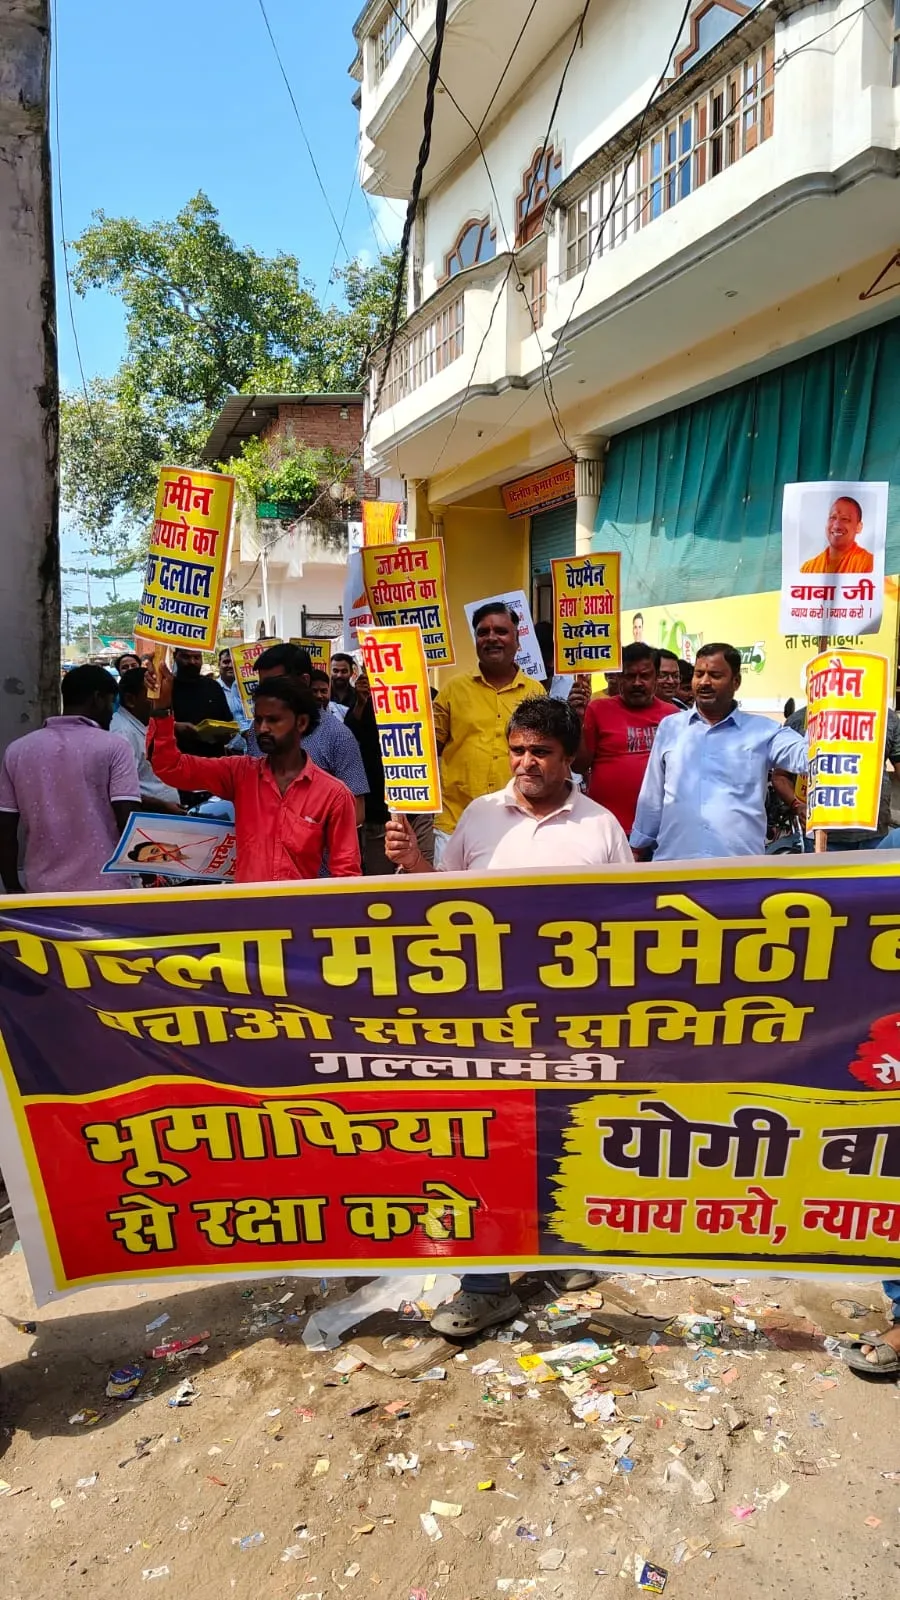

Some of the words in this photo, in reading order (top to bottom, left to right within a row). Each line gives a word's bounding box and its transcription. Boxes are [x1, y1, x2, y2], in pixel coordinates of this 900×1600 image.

[193, 527, 219, 557] का
[374, 546, 429, 575] जमीन
[160, 557, 214, 598] दलाल
[418, 580, 437, 600] का
[791, 585, 836, 601] बाबा
[841, 578, 876, 601] जी
[159, 597, 210, 619] अग्रवाल
[399, 605, 441, 629] दलाल
[584, 589, 615, 616] आओ
[791, 607, 808, 619] न्याय
[809, 605, 824, 619] करो
[830, 607, 847, 619] न्याय
[849, 605, 864, 619] करो
[156, 617, 207, 640] अग्रवाल
[361, 636, 403, 673] मीन
[392, 684, 419, 713] का
[377, 722, 423, 757] लाल
[818, 710, 876, 741] अग्रवाल
[0, 929, 292, 997] गल्ला
[312, 900, 511, 996] मंडी
[537, 892, 848, 988] अमेठी
[349, 1003, 539, 1048] संघर्ष
[556, 996, 814, 1049] समिति
[310, 1052, 624, 1080] गल्लामंडी
[83, 1100, 494, 1187] भूमाफिया
[597, 1101, 800, 1181] योगी
[107, 1193, 178, 1254] से
[192, 1196, 327, 1247] रक्षा
[342, 1180, 480, 1243] करो
[585, 1196, 686, 1236] न्याय
[695, 1187, 788, 1246] करो,
[802, 1198, 900, 1243] न्याय
